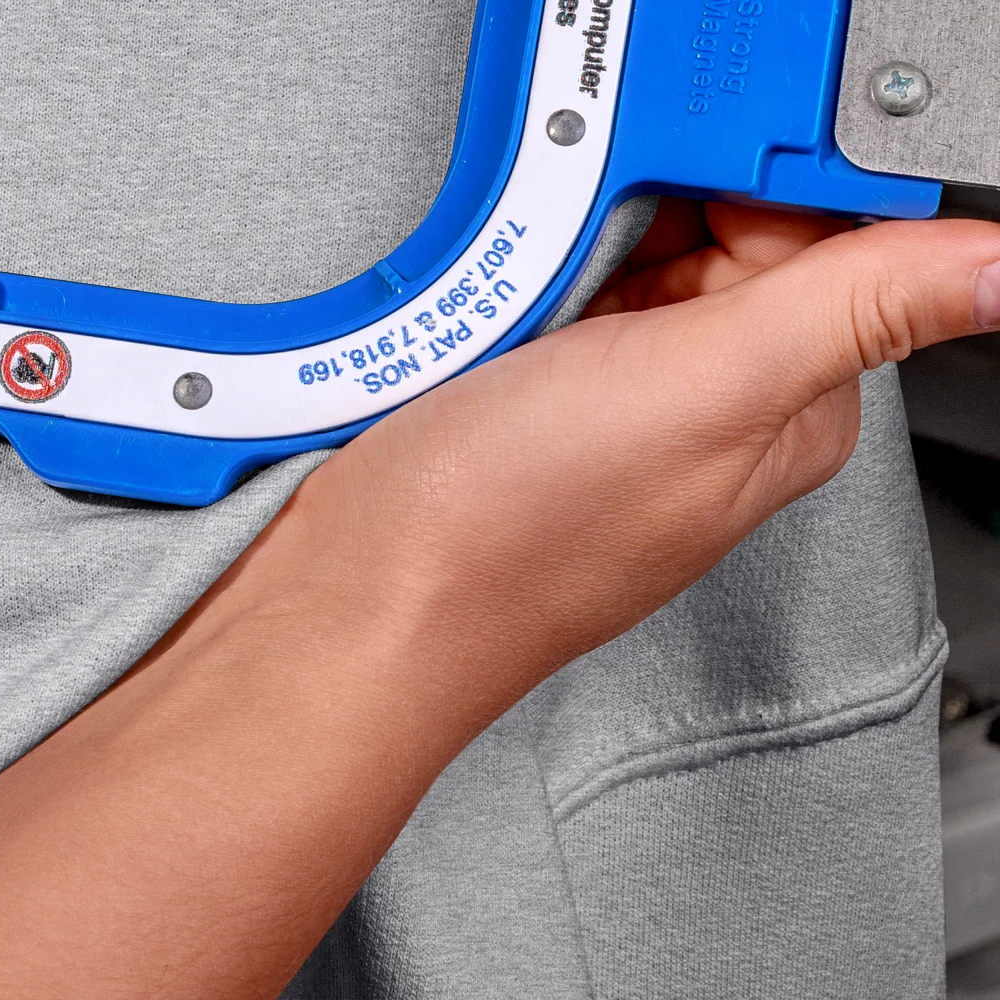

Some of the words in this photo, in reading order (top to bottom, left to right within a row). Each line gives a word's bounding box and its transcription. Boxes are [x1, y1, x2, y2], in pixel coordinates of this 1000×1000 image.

[436, 219, 528, 317] 7,607,399
[468, 279, 517, 319] U.S.
[298, 325, 418, 386] 7,918,169
[420, 319, 474, 363] PAT.
[354, 353, 422, 395] NOS.
